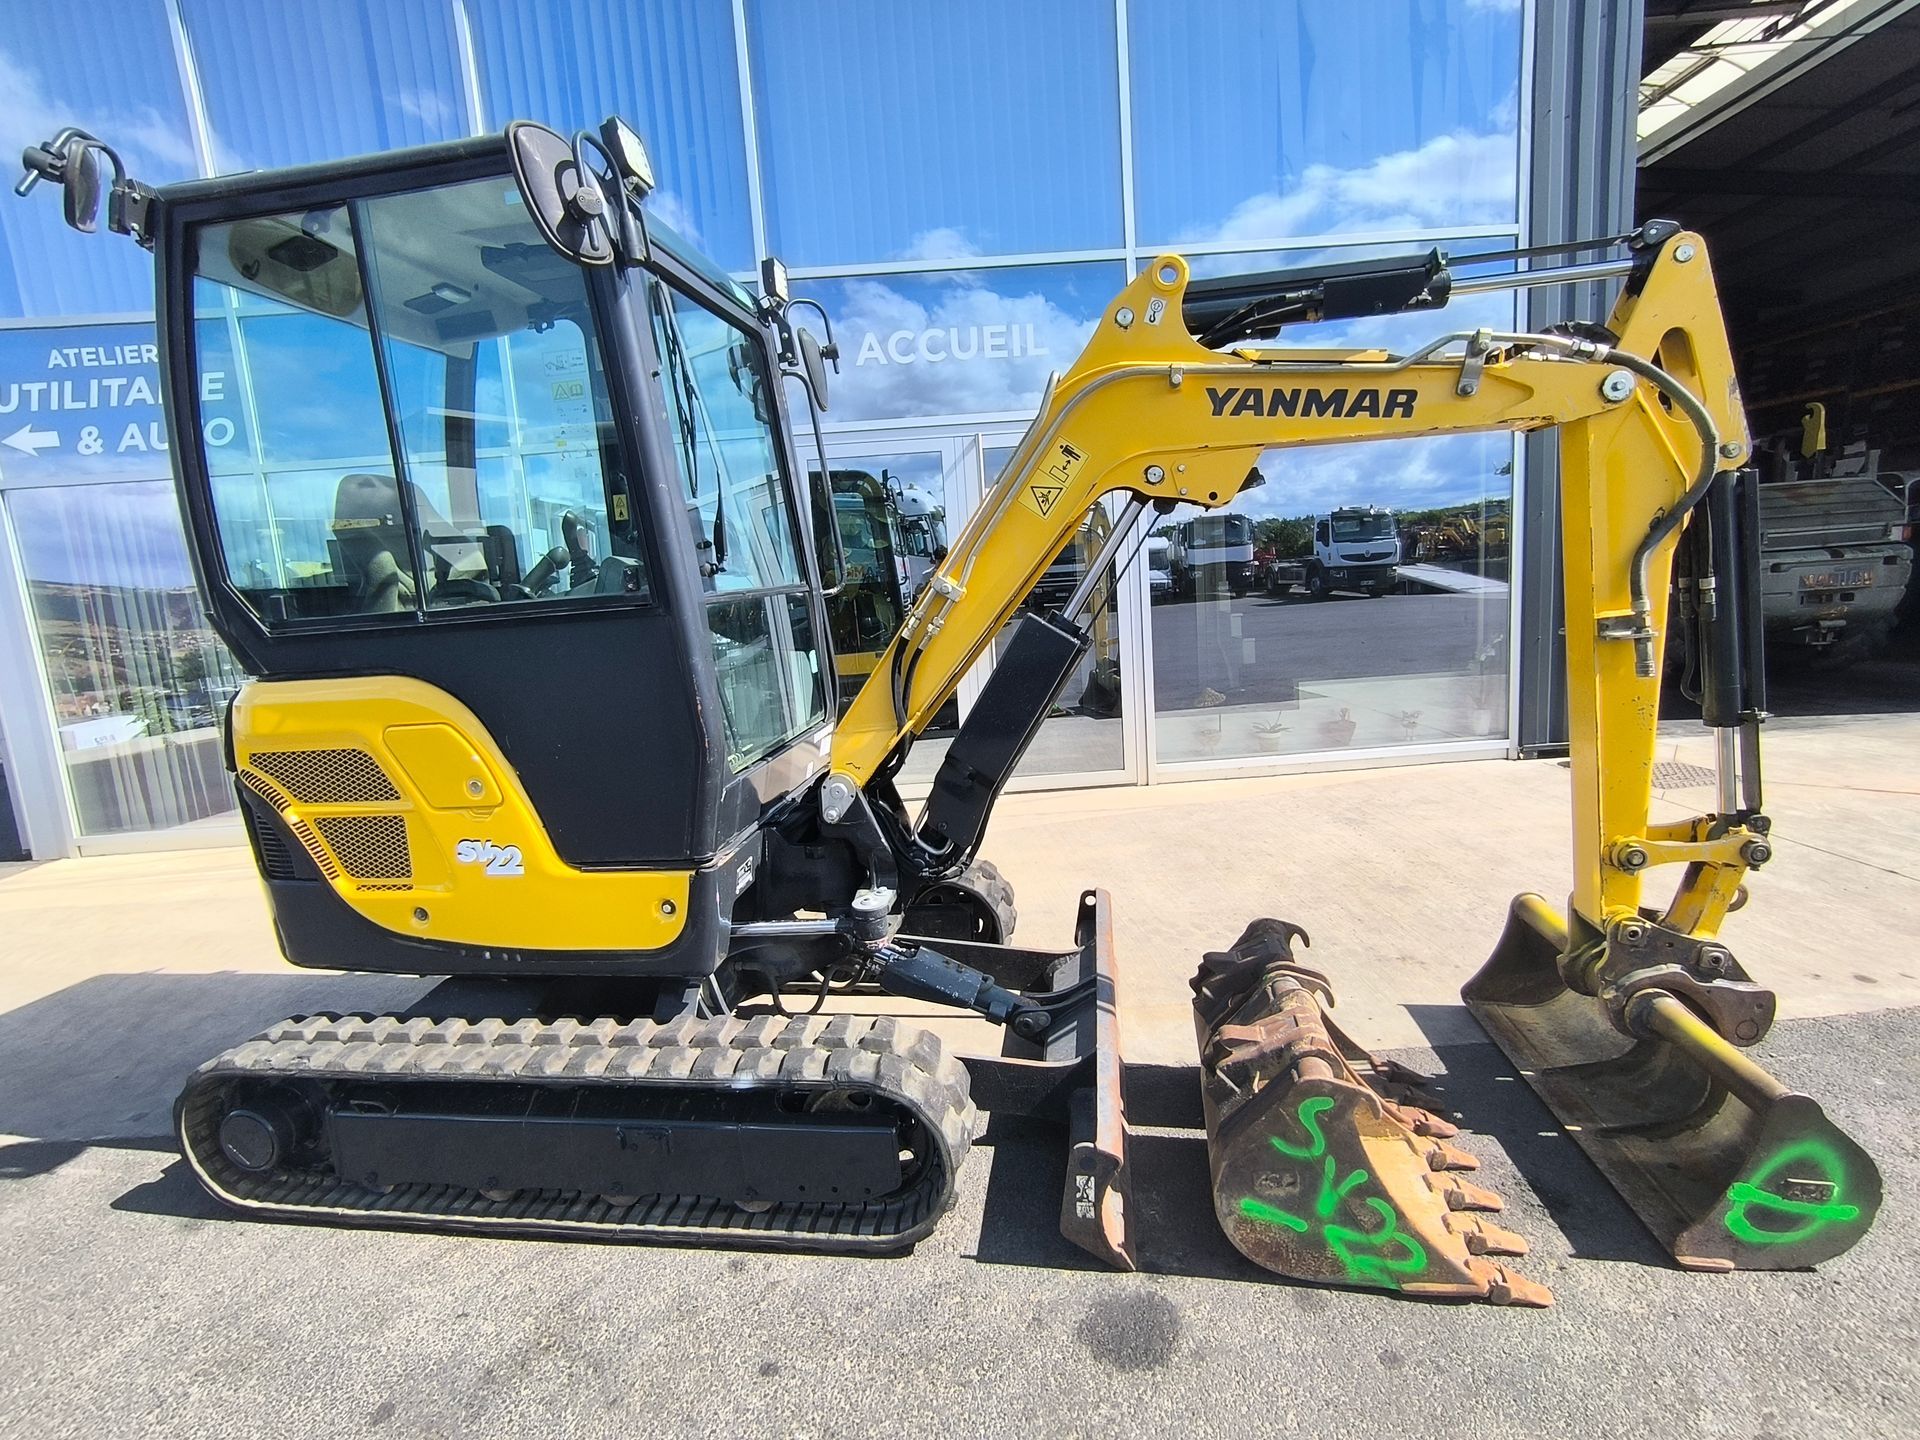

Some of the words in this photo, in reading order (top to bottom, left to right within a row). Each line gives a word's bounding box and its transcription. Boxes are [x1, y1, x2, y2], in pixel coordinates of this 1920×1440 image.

[856, 323, 1051, 366] ACCUEIL
[1205, 387, 1419, 419] YANMAR
[77, 425, 104, 456] &
[117, 417, 235, 453] AUO
[457, 838, 525, 875] SV22
